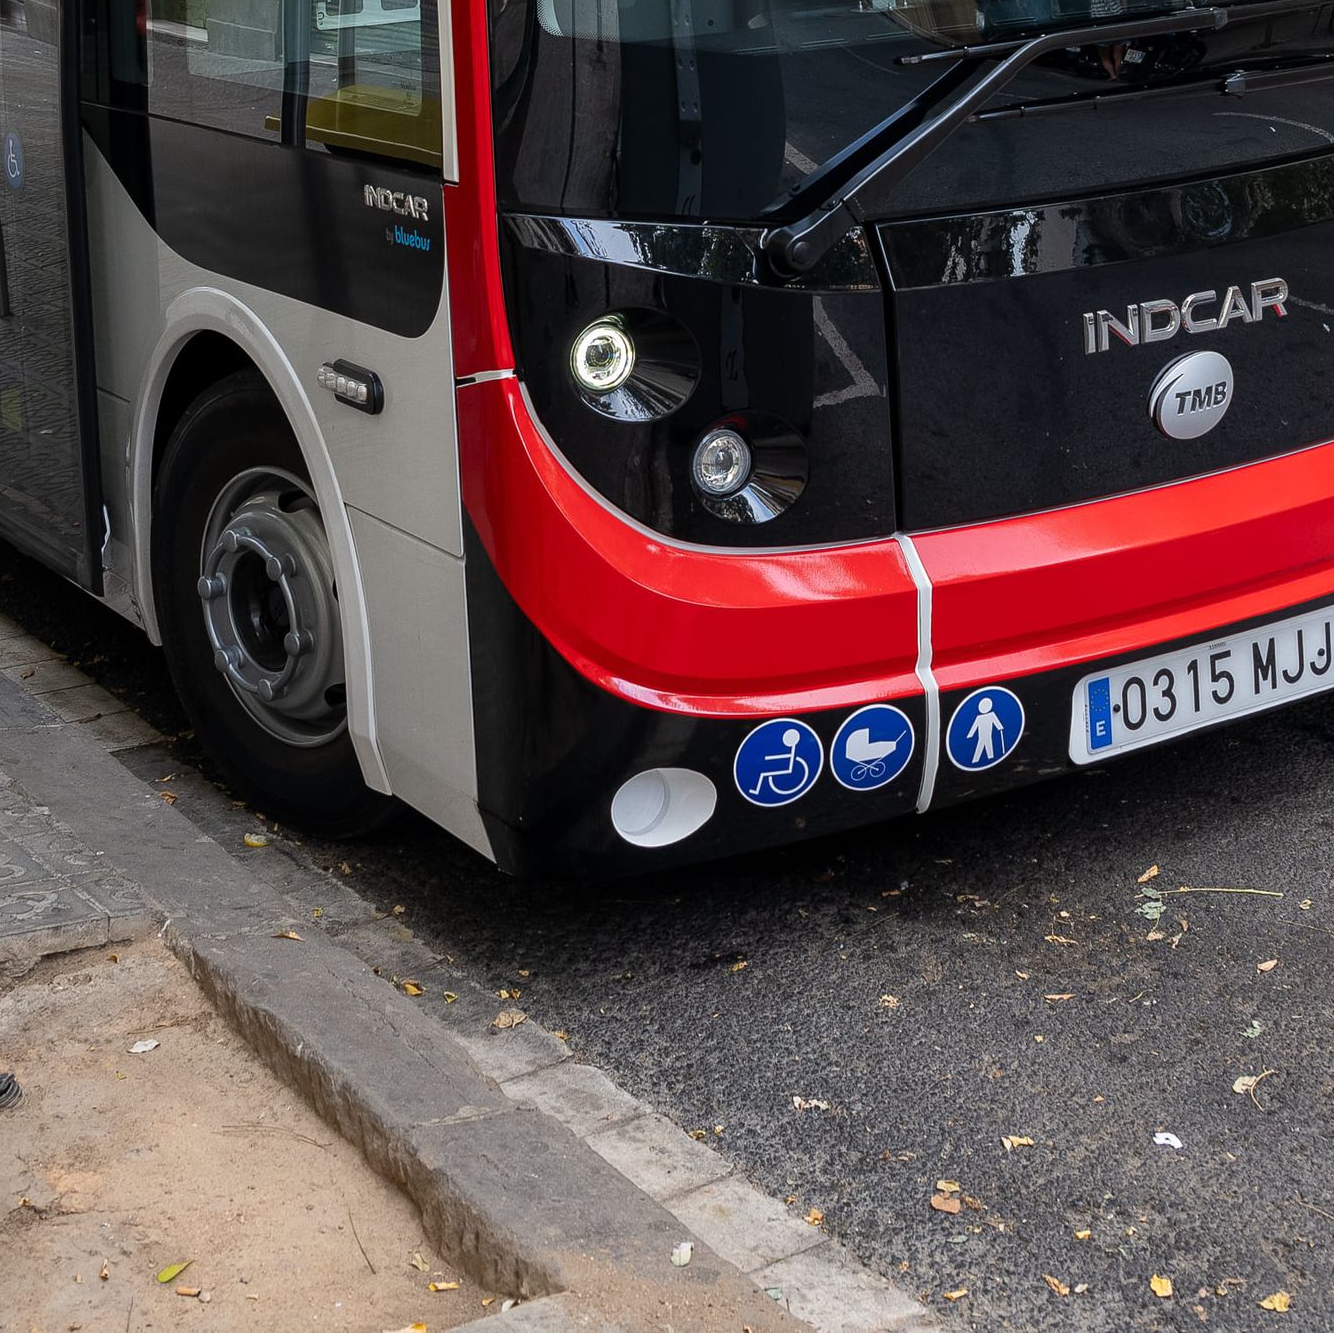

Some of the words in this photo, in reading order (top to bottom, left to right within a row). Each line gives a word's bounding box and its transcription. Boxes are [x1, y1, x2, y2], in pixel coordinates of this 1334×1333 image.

[364, 184, 429, 221] INDCAR
[395, 225, 430, 251] bluebus
[1083, 277, 1288, 354] INDCAR
[1175, 381, 1227, 416] TMB
[1122, 649, 1235, 731] 0315
[1252, 622, 1331, 695] MJJ
[1096, 721, 1105, 736] E
